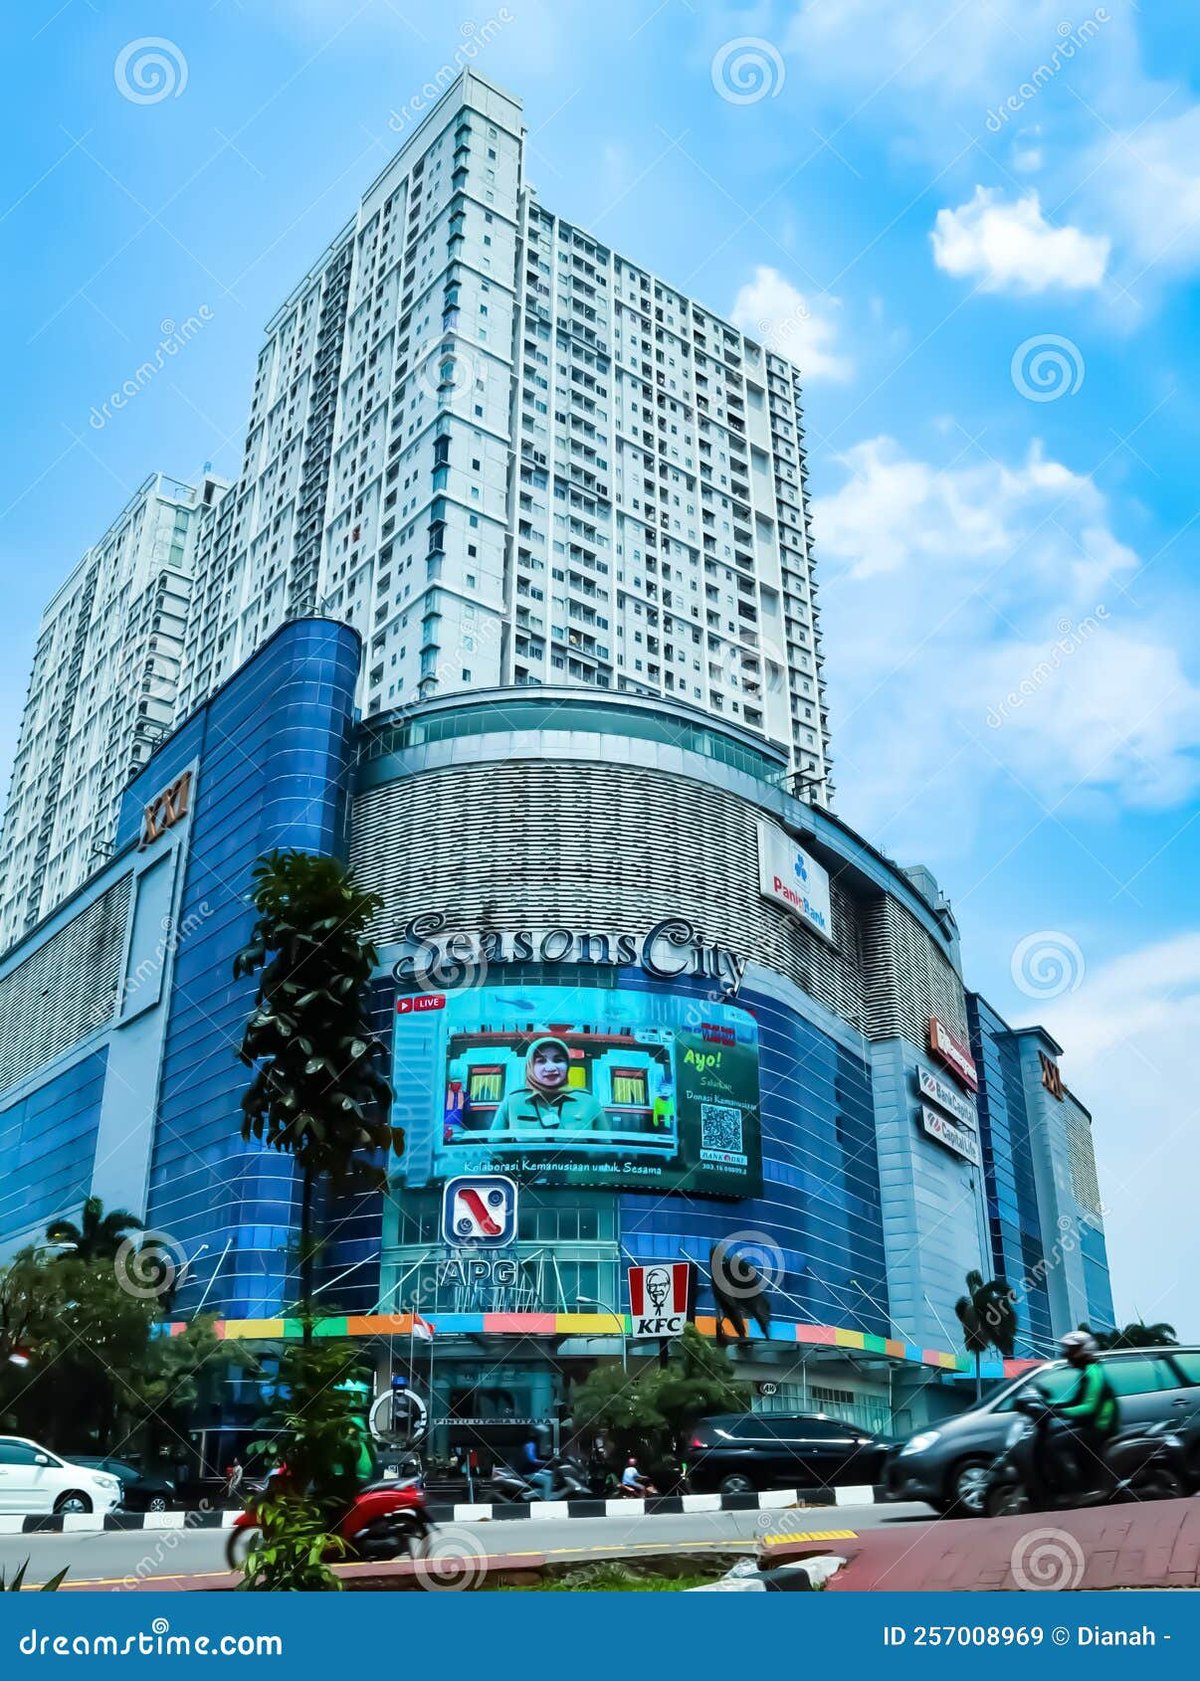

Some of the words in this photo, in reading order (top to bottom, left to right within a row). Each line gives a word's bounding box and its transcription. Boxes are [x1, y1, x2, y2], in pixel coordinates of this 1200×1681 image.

[419, 998, 439, 1008] LIVE
[684, 1049, 721, 1072] Ayo!
[464, 1159, 519, 1172] Kolaborasi
[522, 1160, 590, 1172] Kemanusiaan
[623, 1162, 662, 1175] Sesama
[440, 1259, 517, 1287] APG
[637, 1317, 681, 1335] KFC
